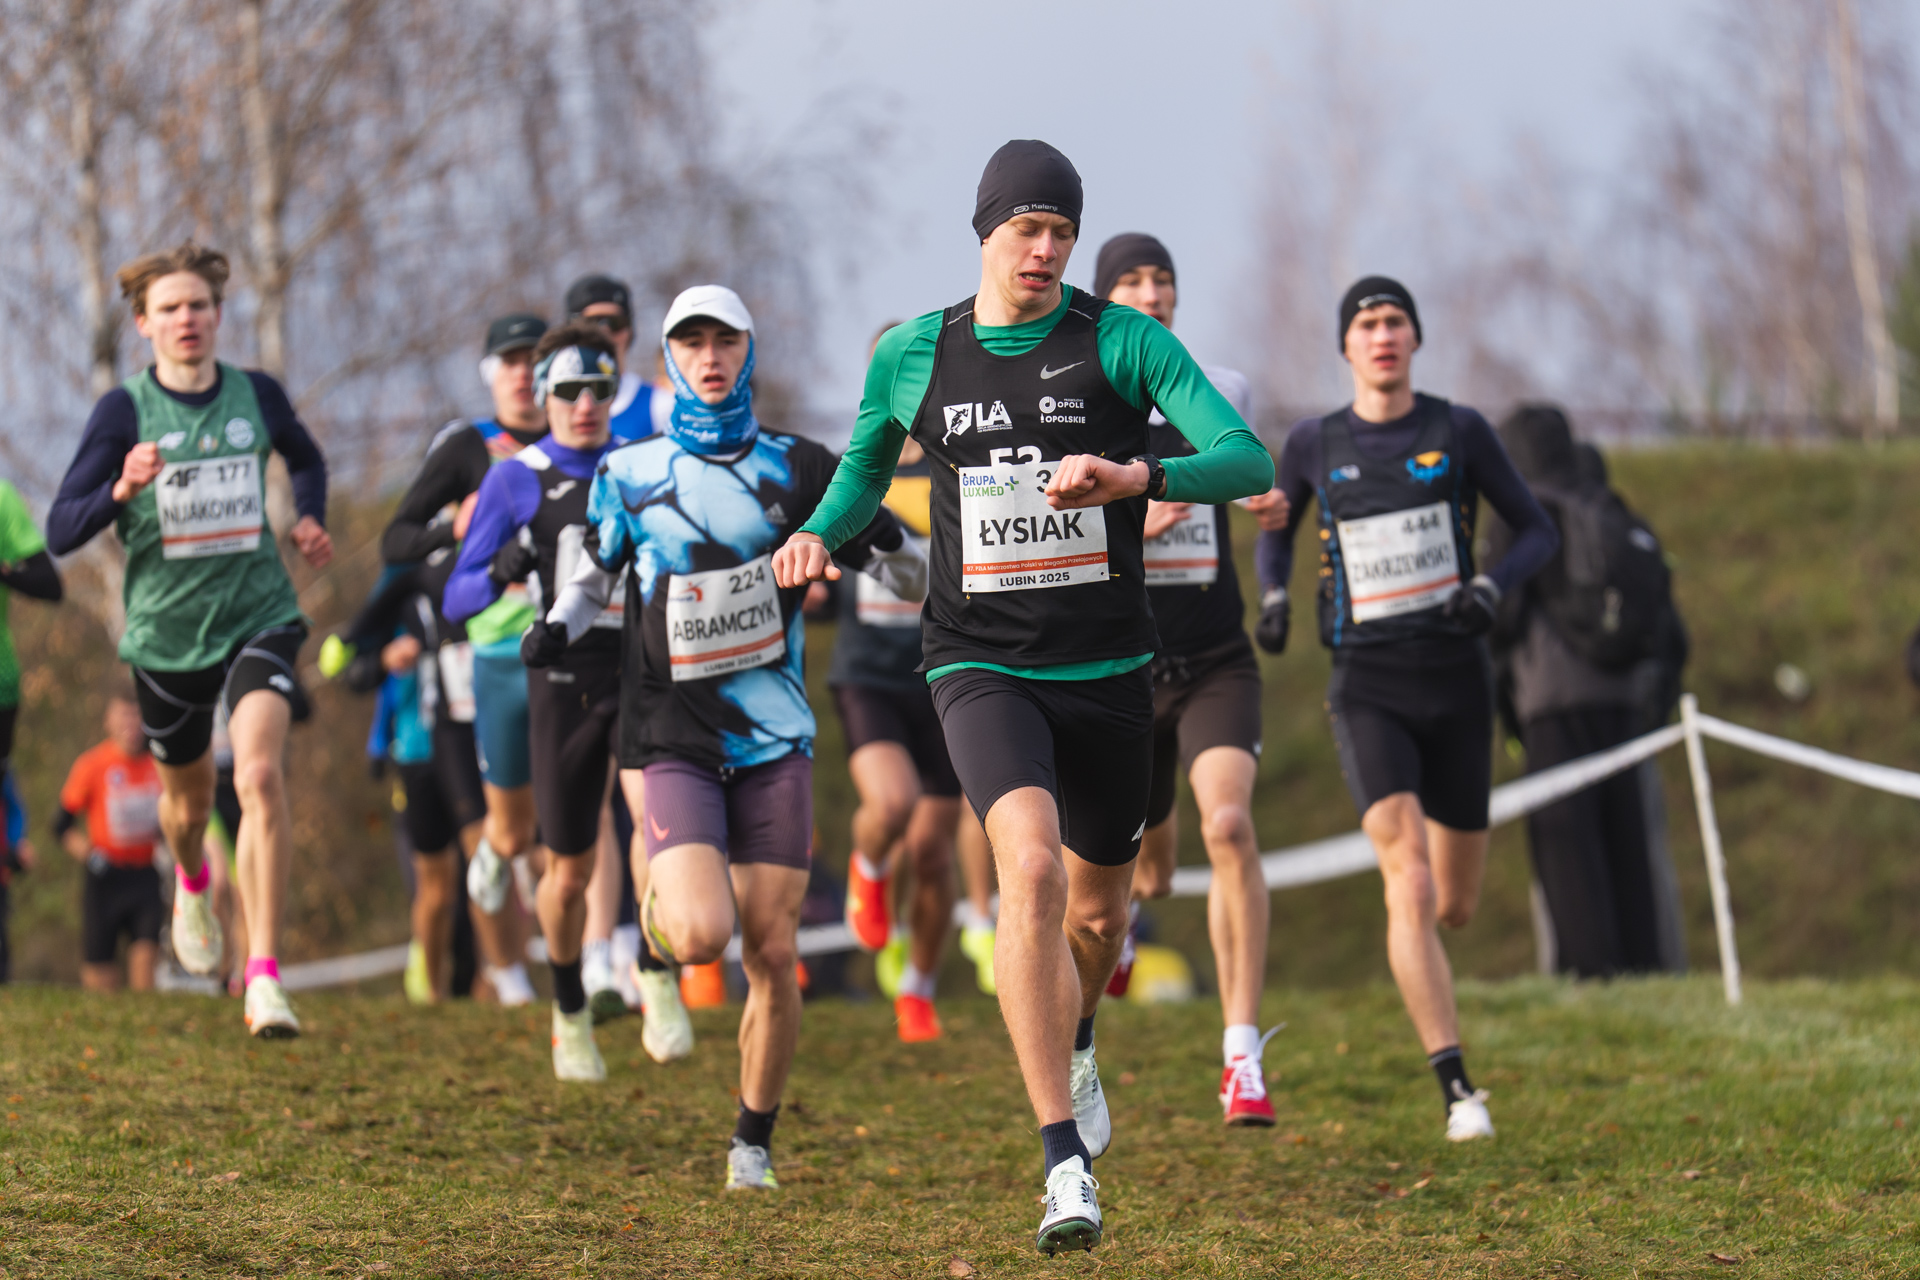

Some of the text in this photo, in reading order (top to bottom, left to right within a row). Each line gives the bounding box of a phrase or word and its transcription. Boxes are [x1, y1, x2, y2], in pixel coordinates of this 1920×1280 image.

[1057, 401, 1084, 409] OPOLE
[1045, 415, 1086, 424] OPOLSKIE
[962, 475, 996, 486] GRUPA
[963, 486, 1005, 497] LUXMED
[979, 511, 1085, 546] ŁYSIAK
[987, 563, 1020, 571] Mistrzostwa
[1044, 559, 1067, 567] Biegach
[1068, 554, 1104, 564] Przełajowych
[729, 564, 765, 595] 224
[1000, 571, 1070, 587] LUBIN 2025
[673, 598, 777, 642] ABRAMCZYK
